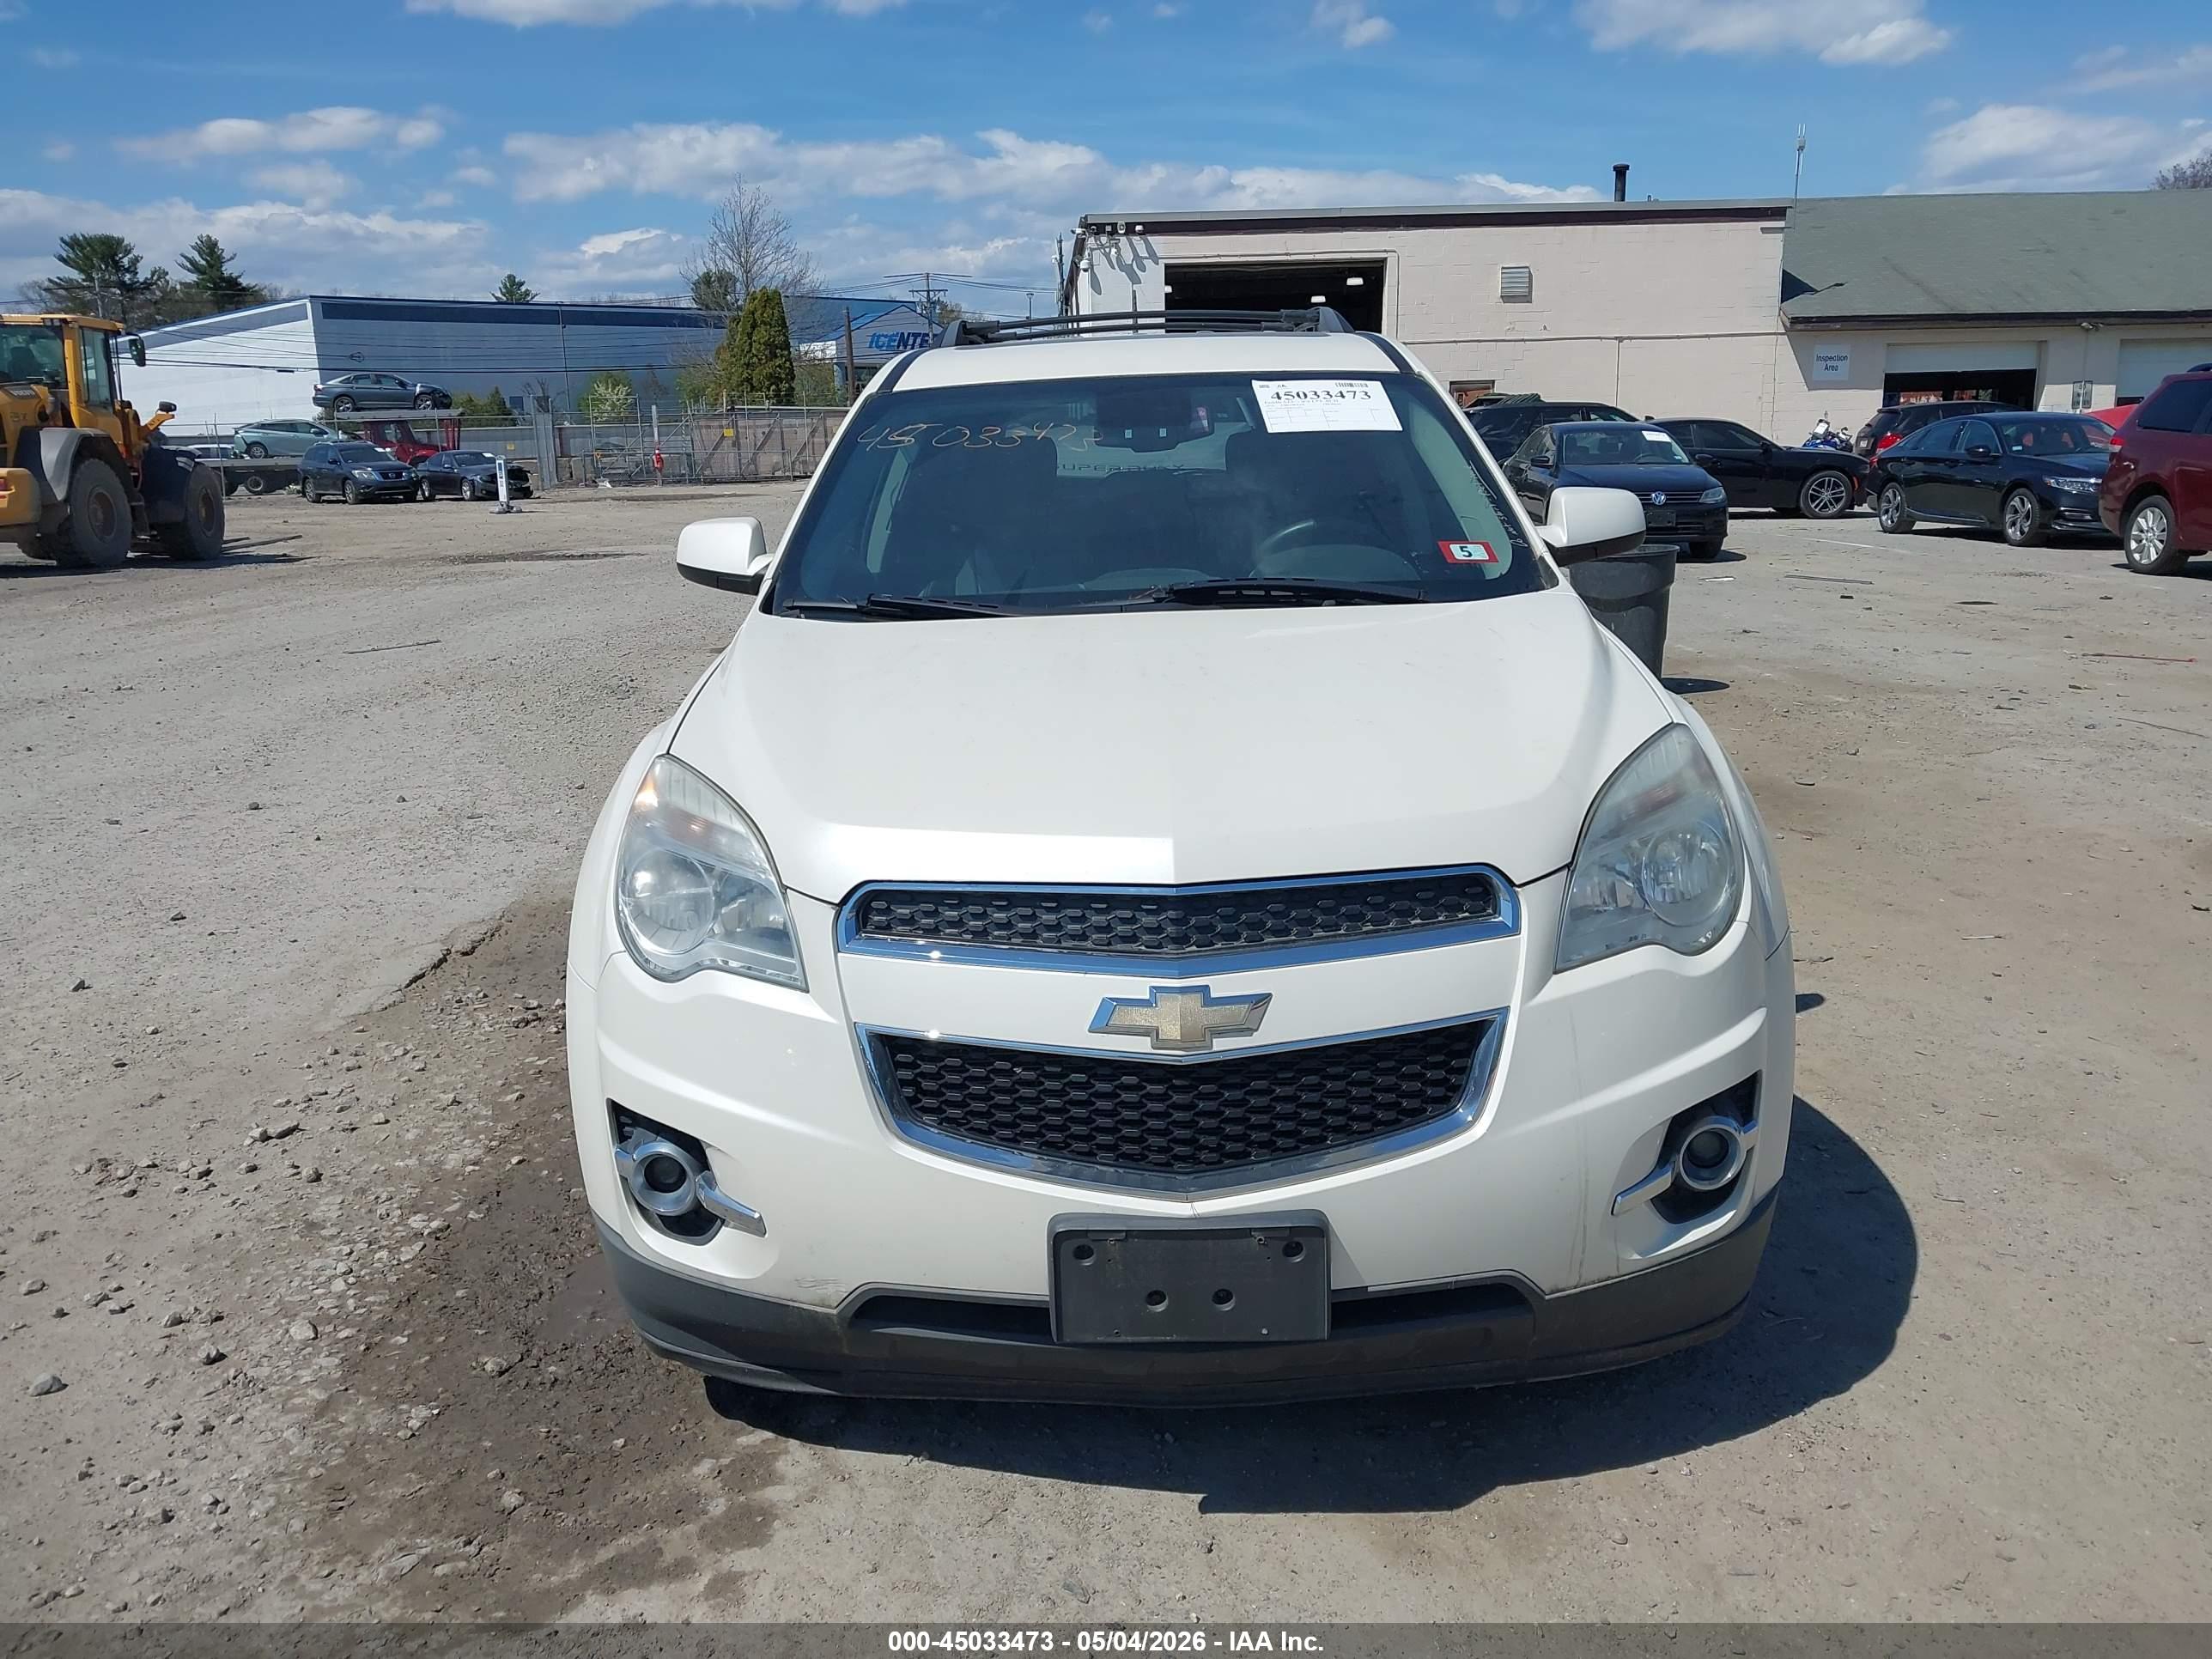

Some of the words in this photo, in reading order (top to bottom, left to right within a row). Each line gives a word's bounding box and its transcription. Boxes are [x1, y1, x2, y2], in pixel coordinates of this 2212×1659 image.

[868, 331, 933, 350] ICENTE
[1816, 354, 1849, 362] Inspection
[1825, 363, 1838, 372] Area
[1271, 390, 1371, 401] 45033473
[1460, 545, 1473, 558] 5
